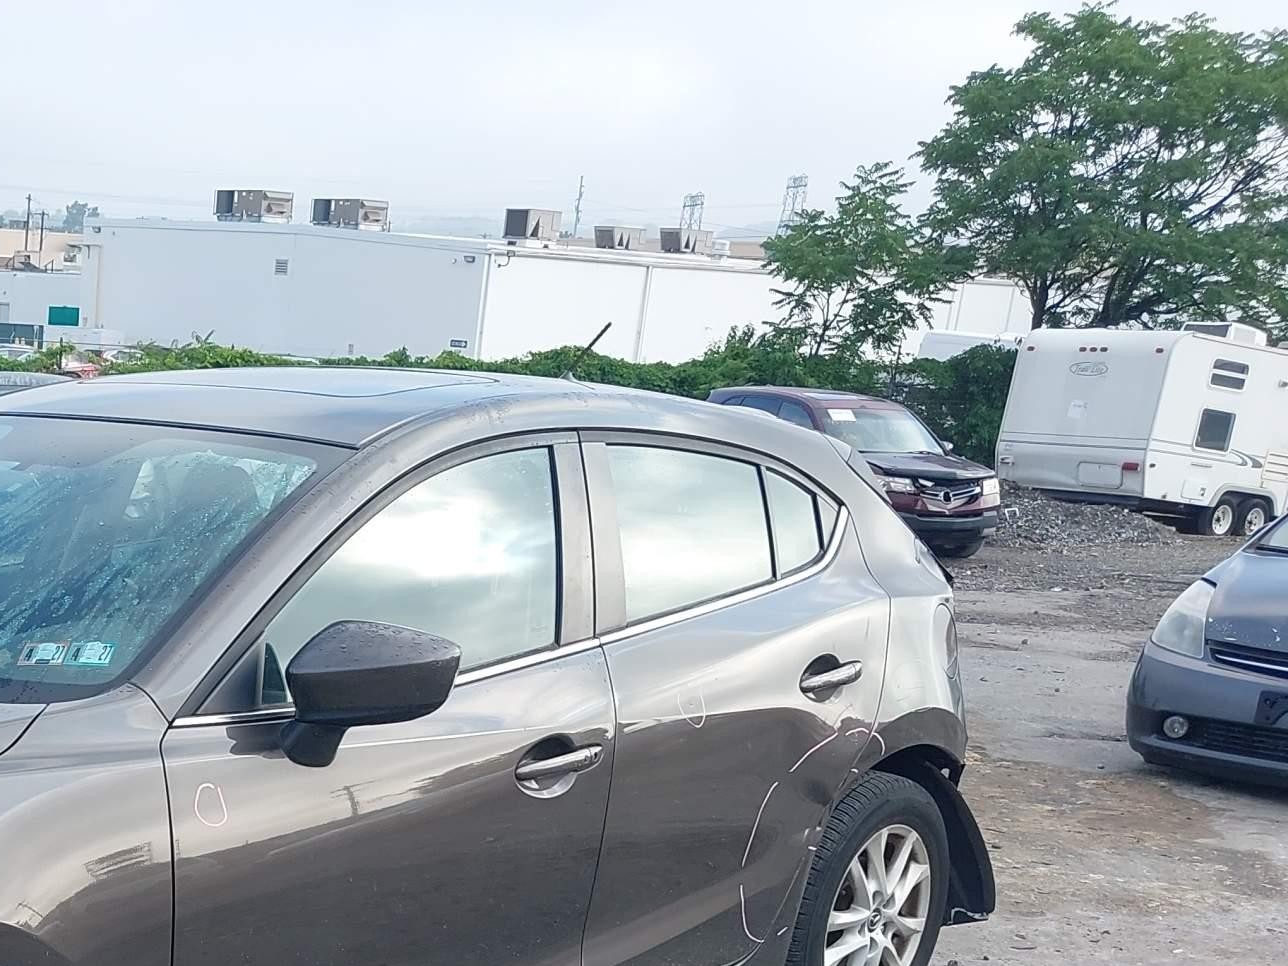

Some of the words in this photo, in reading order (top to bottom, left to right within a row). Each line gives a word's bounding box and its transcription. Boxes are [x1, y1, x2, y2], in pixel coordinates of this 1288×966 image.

[24, 648, 34, 661] 4
[51, 645, 66, 661] 27
[71, 647, 81, 661] 4
[98, 645, 113, 661] 27
